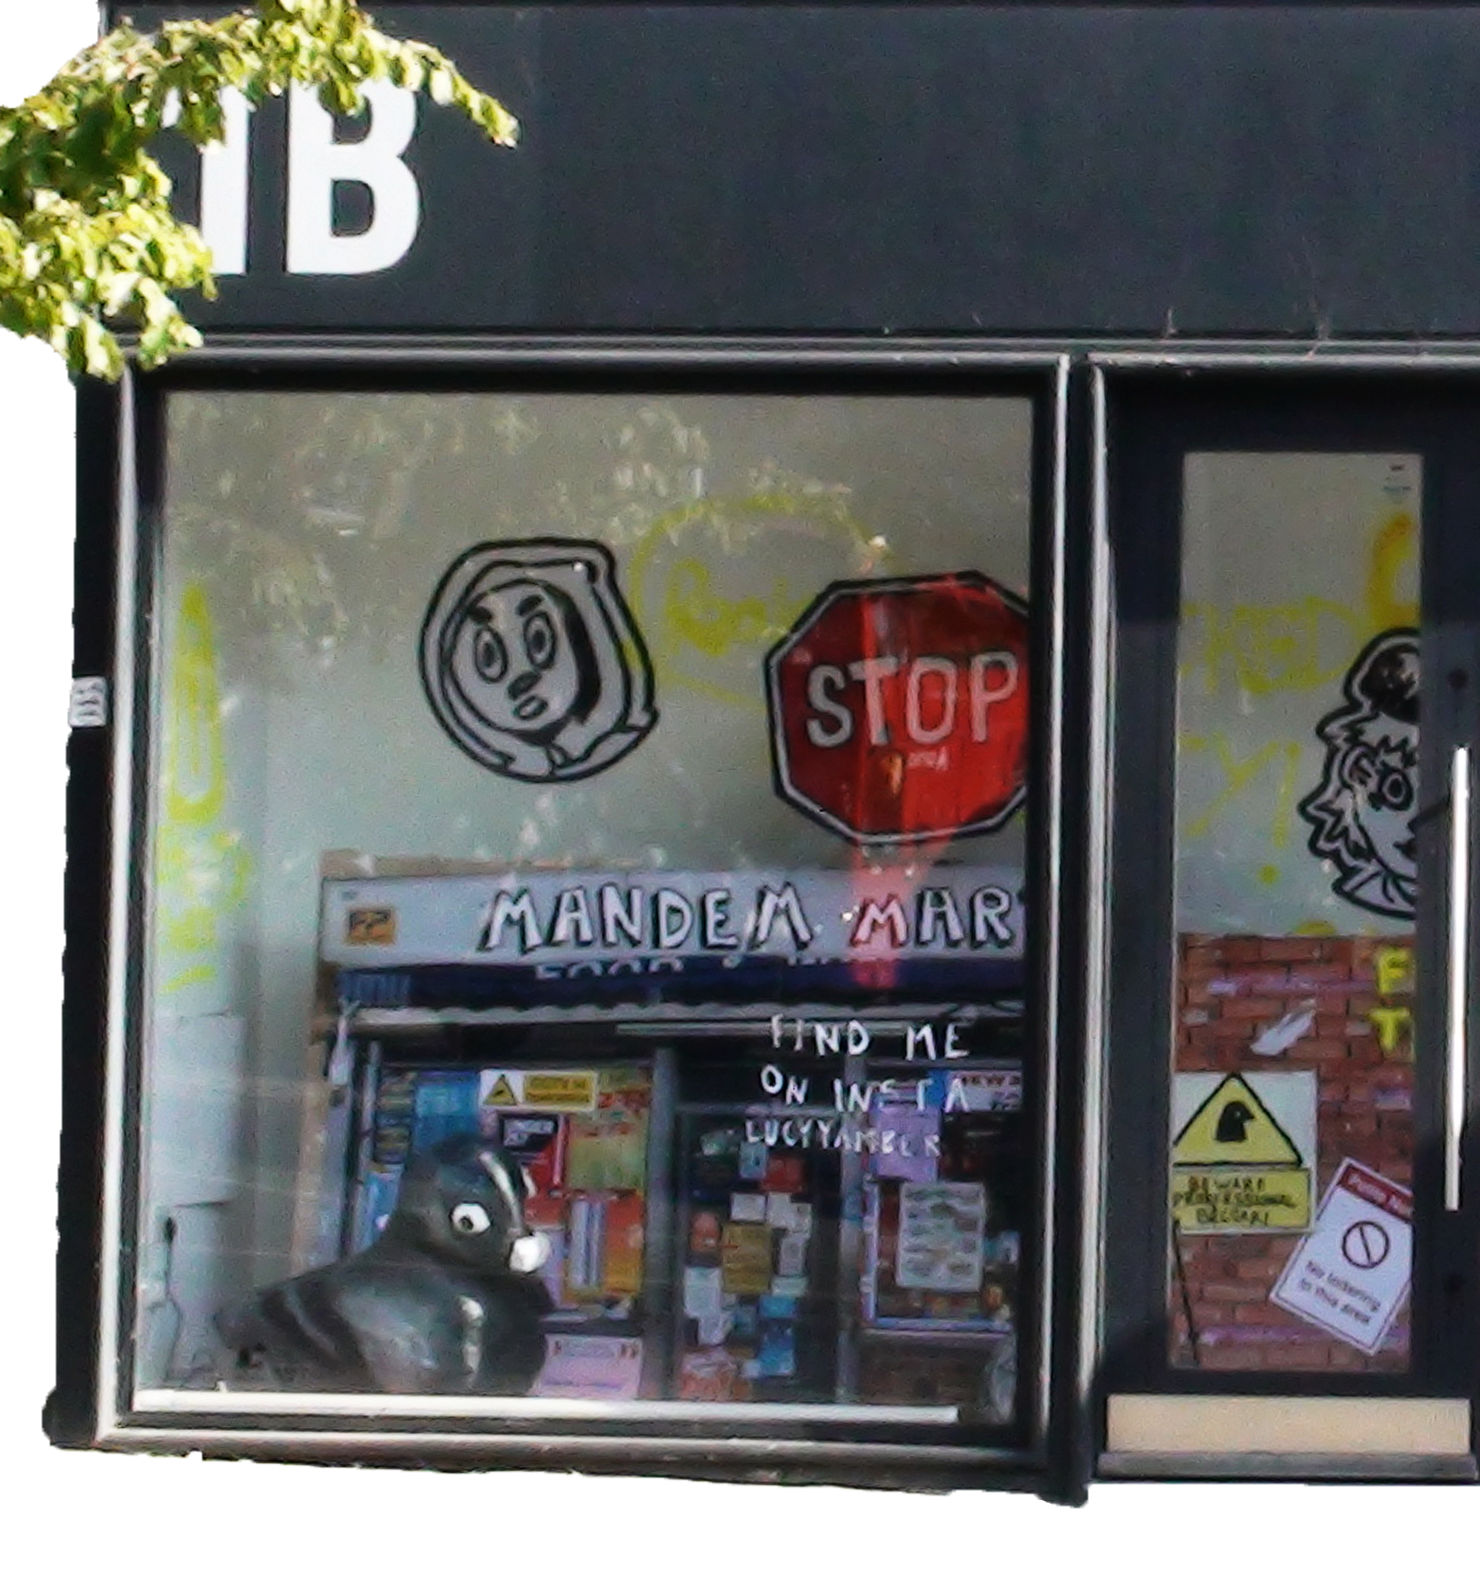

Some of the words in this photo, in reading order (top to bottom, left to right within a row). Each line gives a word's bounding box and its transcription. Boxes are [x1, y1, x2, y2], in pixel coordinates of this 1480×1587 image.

[806, 651, 1018, 747] STOP
[478, 882, 813, 953] MANDEM
[850, 883, 1026, 951] MAR
[771, 1014, 869, 1056] FIND
[906, 1023, 970, 1060] ME
[760, 1064, 808, 1105] ON
[1327, 1272, 1381, 1313] loitering
